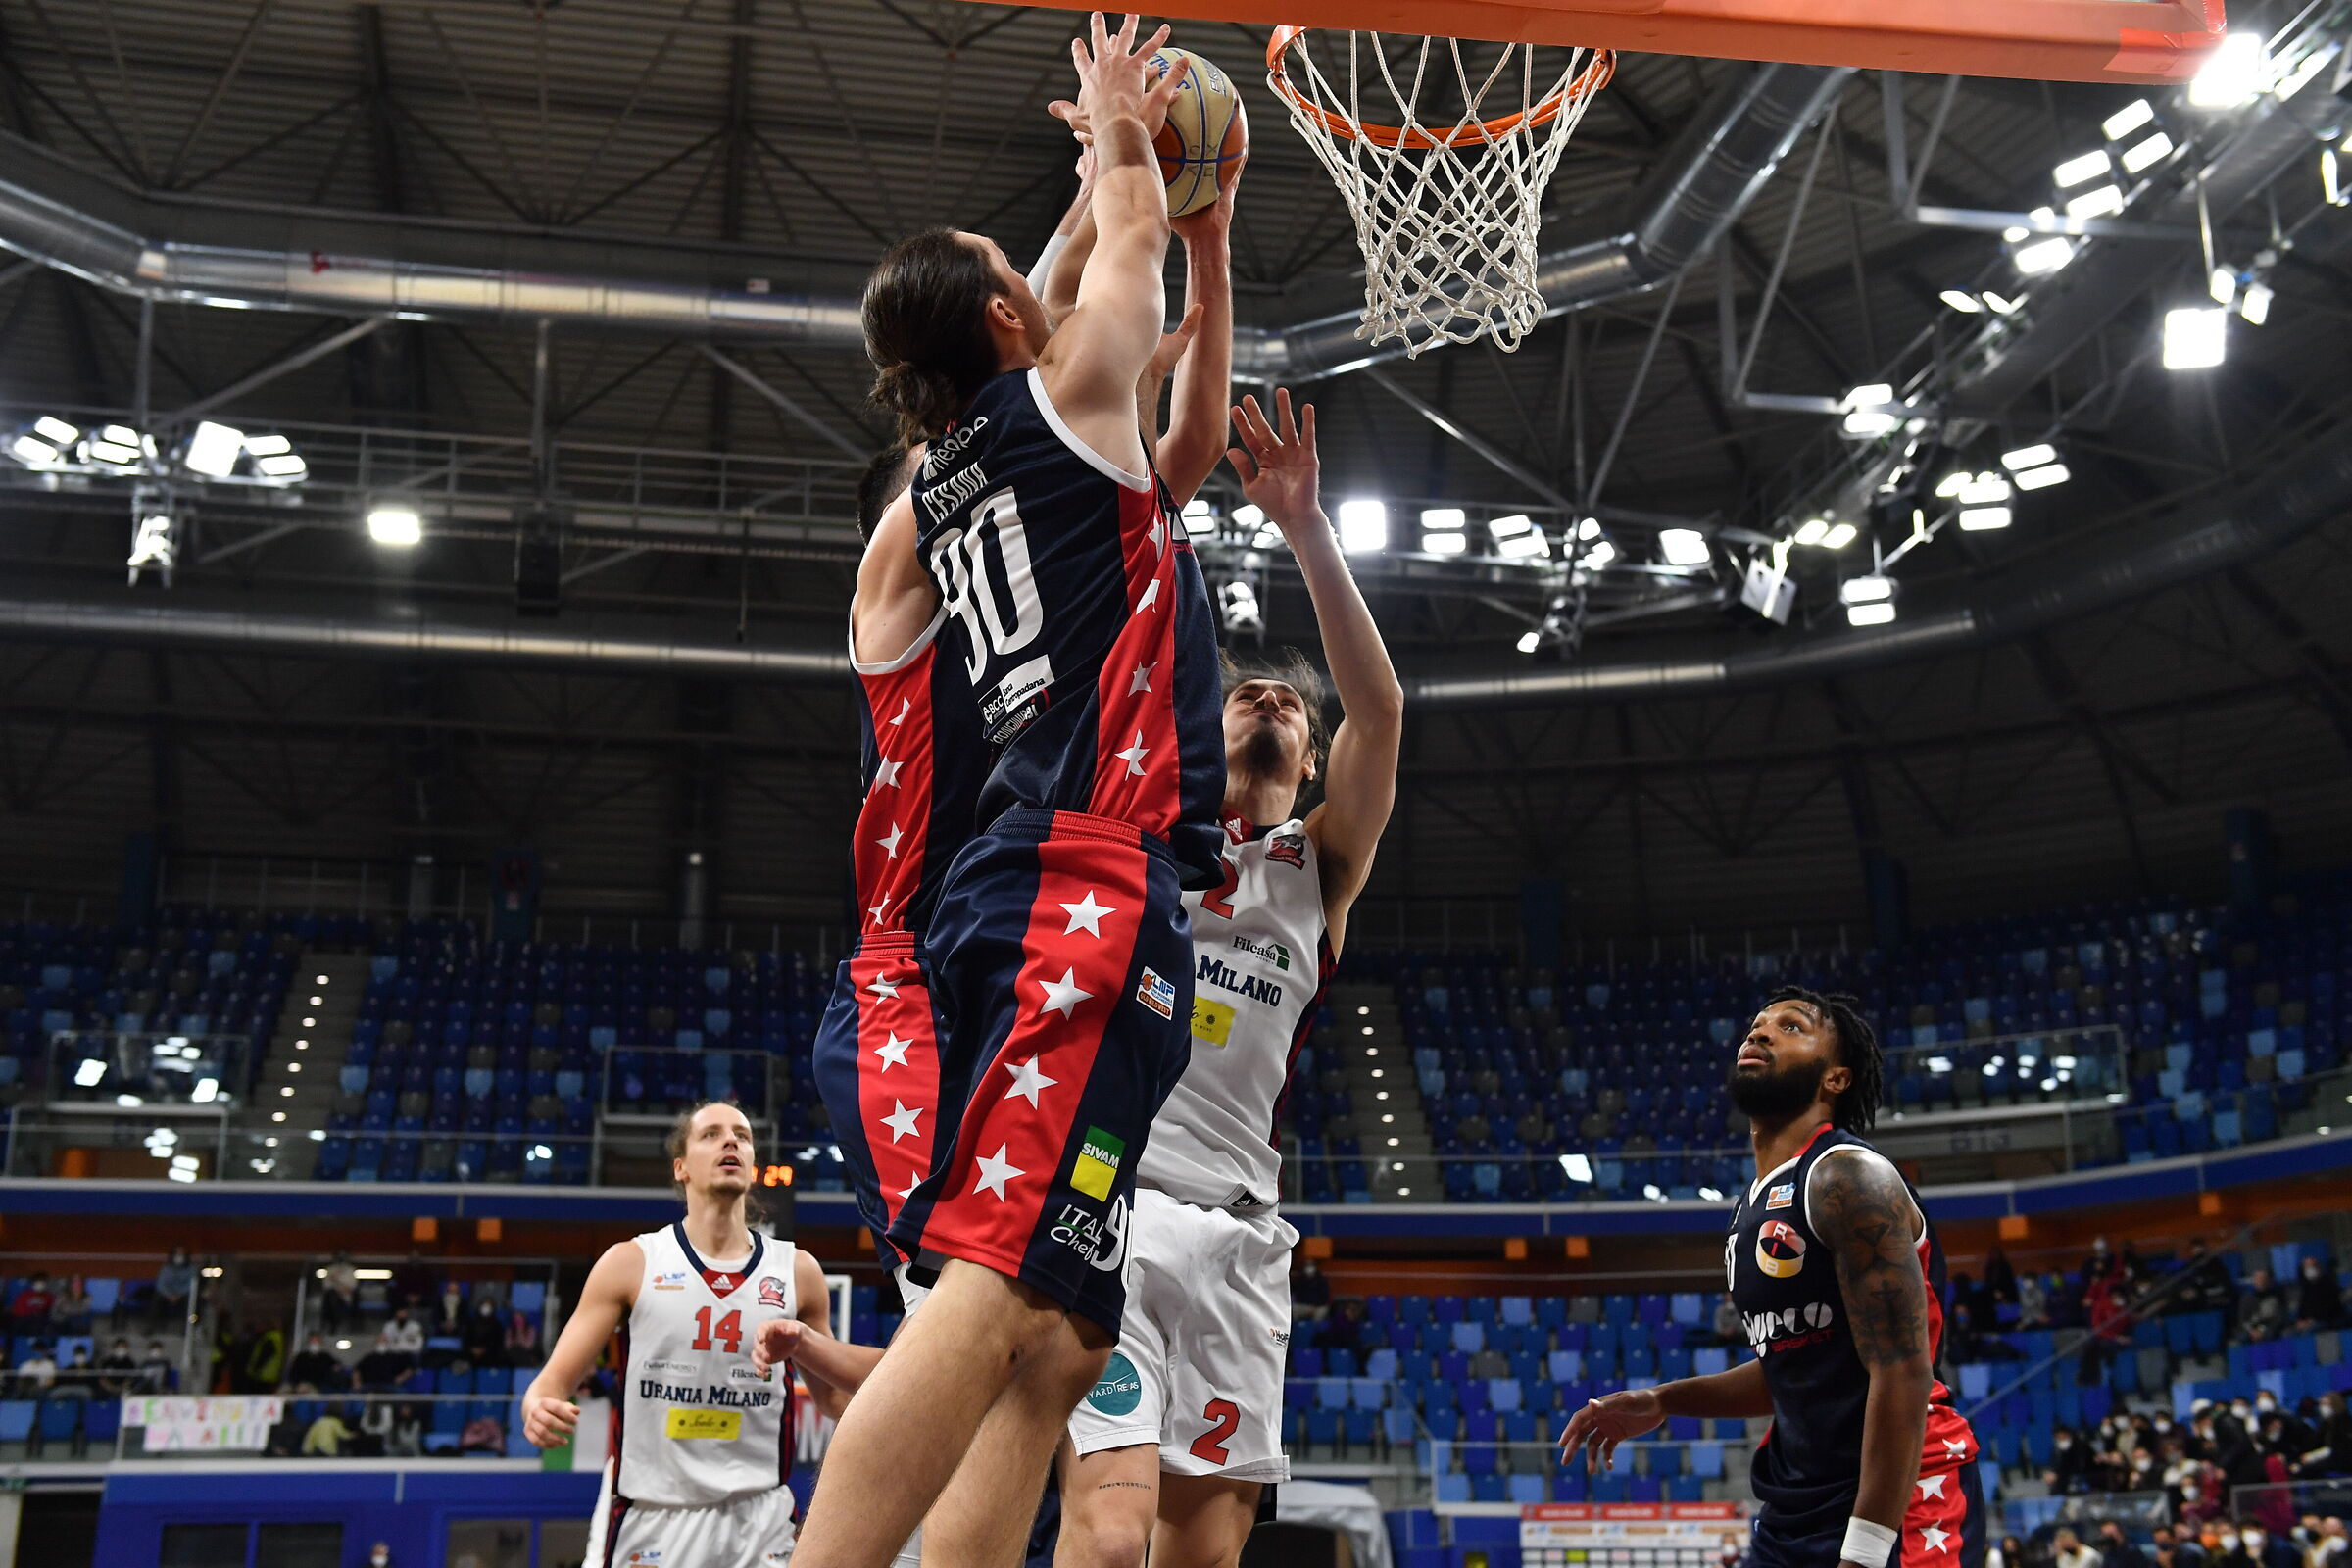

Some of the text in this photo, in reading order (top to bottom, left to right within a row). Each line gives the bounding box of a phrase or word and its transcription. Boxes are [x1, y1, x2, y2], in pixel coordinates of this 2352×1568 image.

[930, 485, 1044, 686] 90
[1232, 935, 1276, 961] Filcasa
[1196, 954, 1283, 1007] MILANO
[1081, 1142, 1120, 1169] SIVAM
[1050, 1225, 1097, 1261] Chef
[691, 1305, 743, 1353] 14
[640, 1380, 771, 1407] URANIA MILANO
[1088, 1386, 1113, 1399] YARD
[1189, 1397, 1241, 1467] 2
